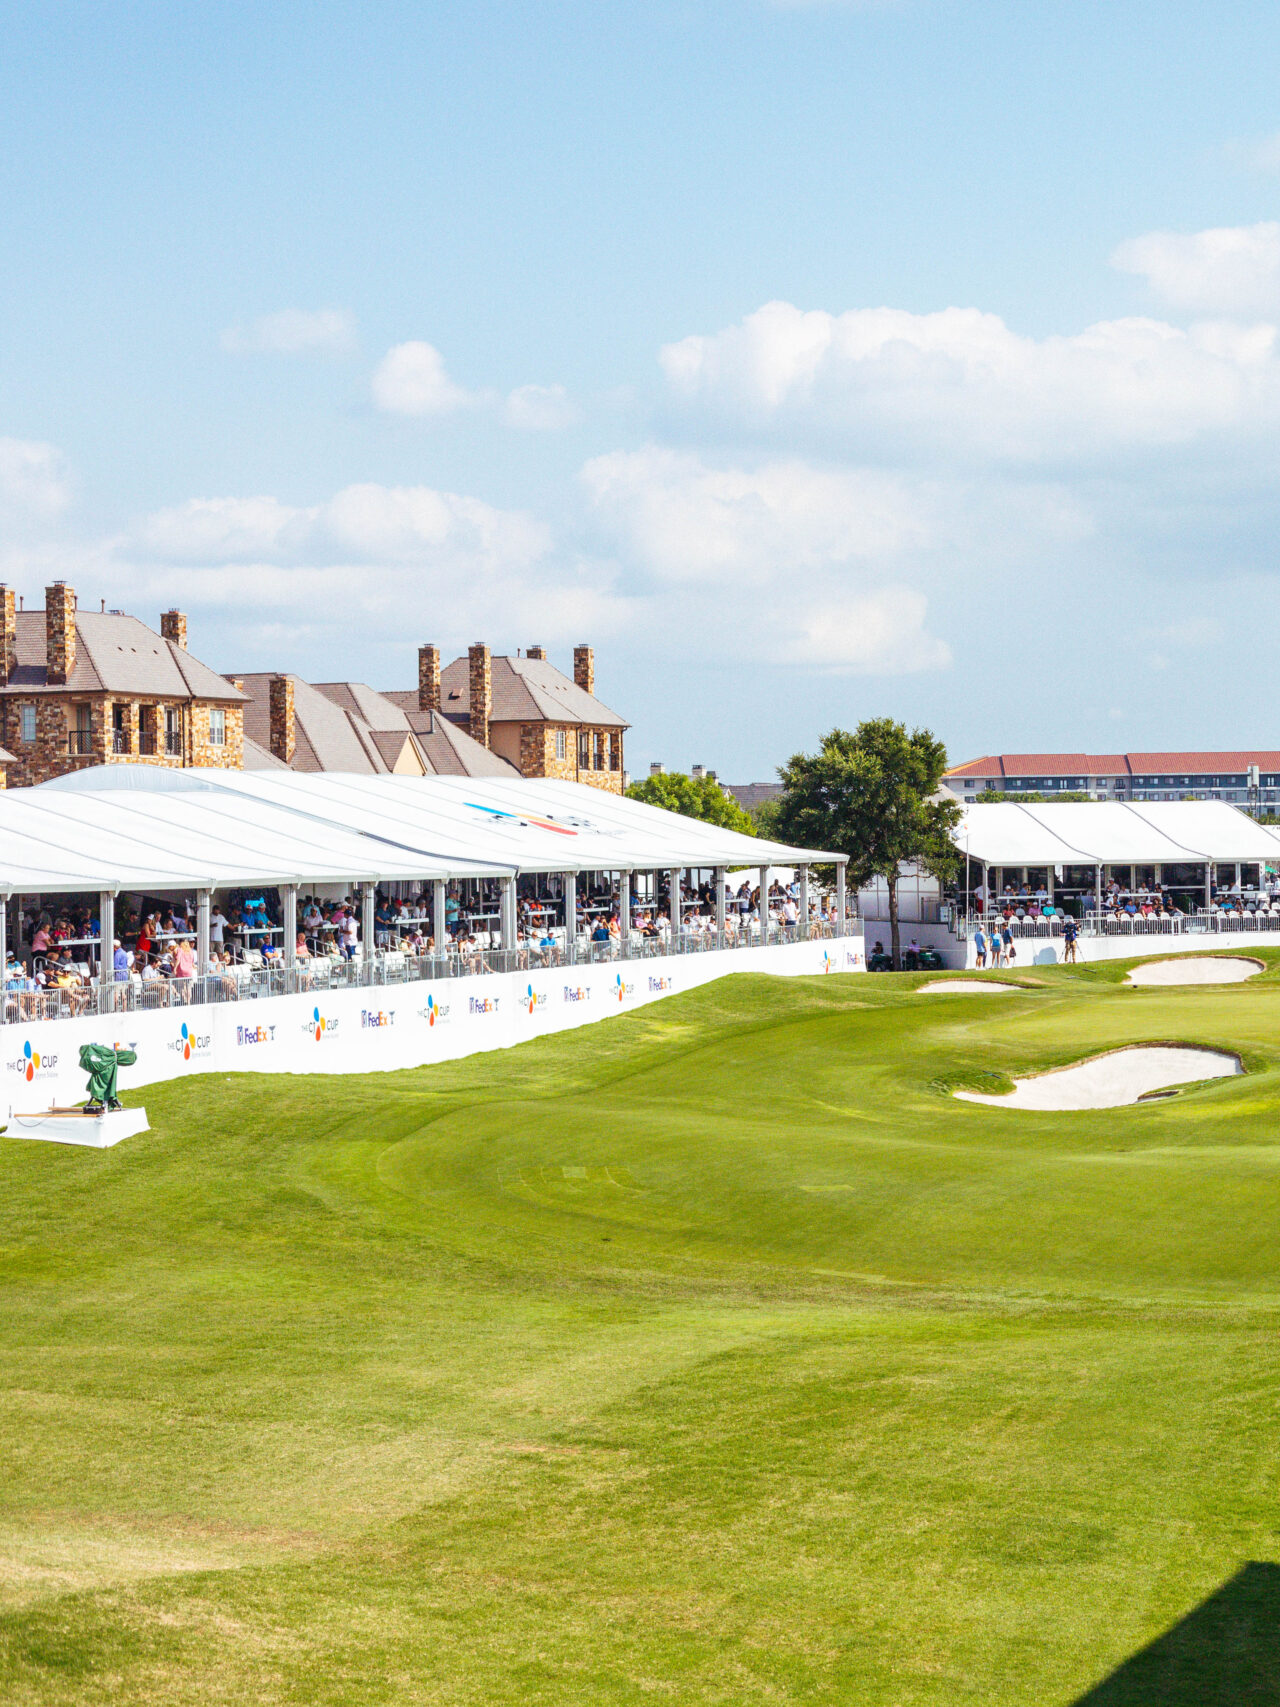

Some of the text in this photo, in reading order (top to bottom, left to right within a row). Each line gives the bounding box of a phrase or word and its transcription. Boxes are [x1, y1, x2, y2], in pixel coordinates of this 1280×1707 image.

[475, 998, 493, 1013] FedEx
[327, 1019, 339, 1031] CUP
[368, 1011, 388, 1027] FedEx
[245, 1026, 268, 1045] FedEx
[176, 1039, 184, 1053] CJ
[197, 1036, 211, 1048] CUP
[6, 1055, 58, 1074] THE CJ CUP
